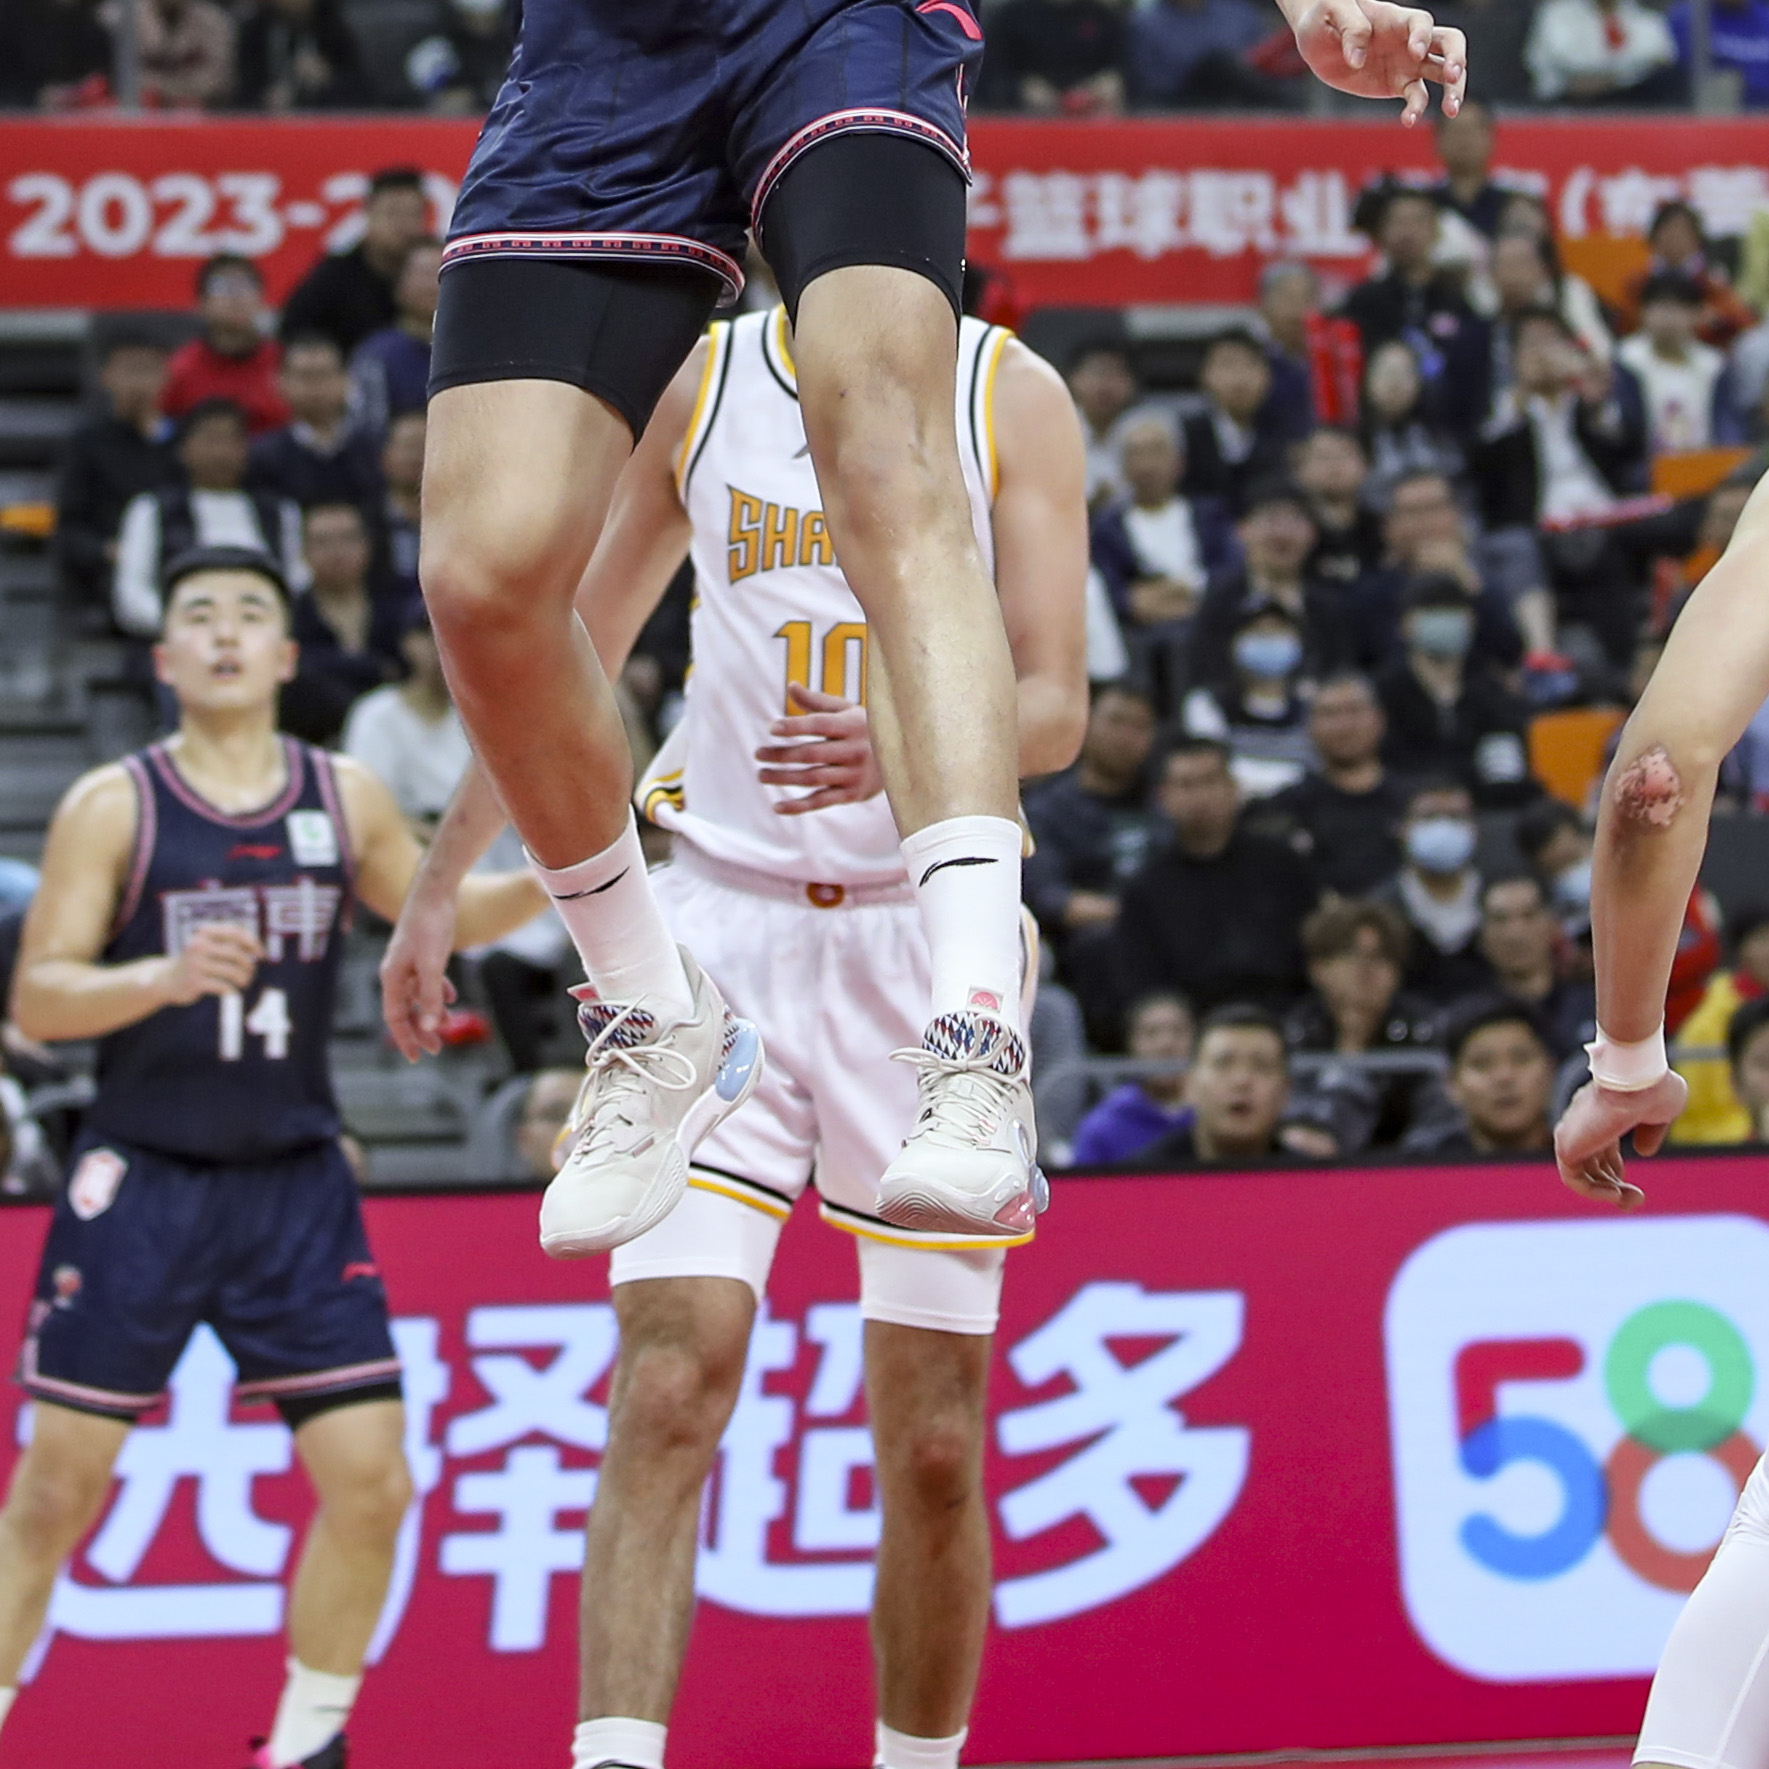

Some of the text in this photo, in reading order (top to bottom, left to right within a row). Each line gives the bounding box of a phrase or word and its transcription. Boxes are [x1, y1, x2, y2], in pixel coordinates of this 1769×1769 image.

[726, 483, 844, 585] SHA
[218, 985, 295, 1063] 14
[1453, 1298, 1762, 1596] 58
